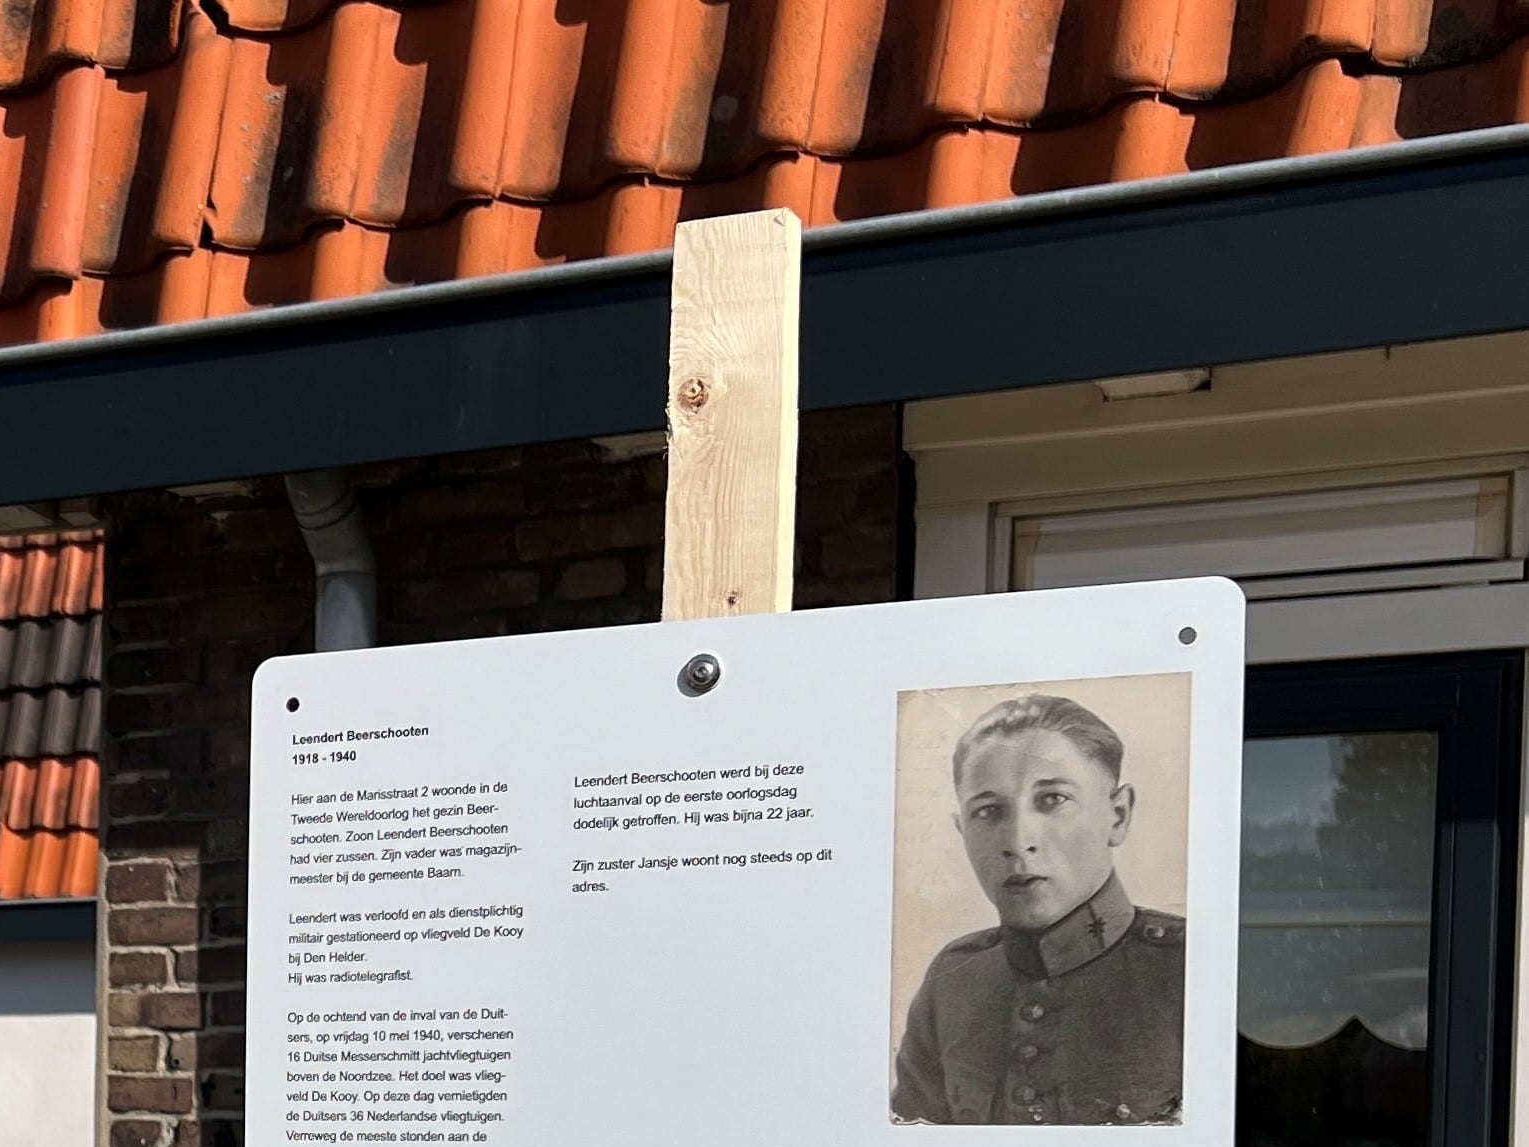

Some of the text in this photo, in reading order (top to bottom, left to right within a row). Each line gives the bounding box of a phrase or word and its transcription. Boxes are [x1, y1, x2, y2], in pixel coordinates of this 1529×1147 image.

[292, 725, 428, 745] Leendert Beerschooten
[291, 752, 318, 765] 1918
[329, 750, 356, 762] 1940
[574, 763, 804, 787] Leendert Beerschooten werd bij deze
[291, 781, 507, 805] Hier aan de Marisstraat 2 woonde in de
[573, 785, 797, 808] luchtaanval op de eerste oorlogsdag
[290, 803, 499, 824] Tweede Wereldoorlog het gezin Beer-
[572, 806, 814, 831] dodelijk getroffen. Hij was bijna 22 jaar.
[290, 823, 508, 845] schooten. Zoon Leendert Beerschooten
[289, 842, 522, 864] had vier zussen. Zijn vader was magazijn-
[571, 848, 832, 874] Zijn zuster Jansje woont nog steeds op dit
[289, 872, 333, 884] meester
[336, 871, 348, 885] bij
[351, 870, 365, 881] de
[368, 868, 424, 883] gemeente
[571, 880, 609, 892] adres.
[288, 904, 523, 924] Leendert was verloofd en als dienstplichtig
[288, 925, 524, 945] militair gestationeerd op vliegveld De Kooy
[288, 952, 300, 966] bij
[303, 952, 325, 963] Den
[287, 969, 413, 986] Hij was radiotelegrafist.
[287, 1011, 303, 1025] Op
[306, 1011, 320, 1022] de
[322, 1010, 366, 1022] ochtend
[369, 1012, 390, 1021] van
[392, 1010, 407, 1021] de
[409, 1009, 436, 1020] inval
[438, 1011, 459, 1020] van
[462, 1008, 478, 1019] de
[287, 1028, 513, 1044] sers, op vrijdag 10 mei 1940, verschenen
[287, 1049, 511, 1063] 16 Duitse Messerschmitt jachtvliegtuigen
[286, 1069, 506, 1083] boven de Noordzee. Het doel was vlieg-
[285, 1090, 308, 1101] veld
[311, 1090, 327, 1101] De
[363, 1090, 380, 1104] Op
[382, 1090, 410, 1101] deze
[413, 1090, 434, 1104] dag
[437, 1089, 507, 1103] vernietigden
[285, 1110, 504, 1124] de Duitsers 36 Nederlandse vliegtuigen.
[285, 1129, 487, 1143] Verreweg de meeste stonden aan de
